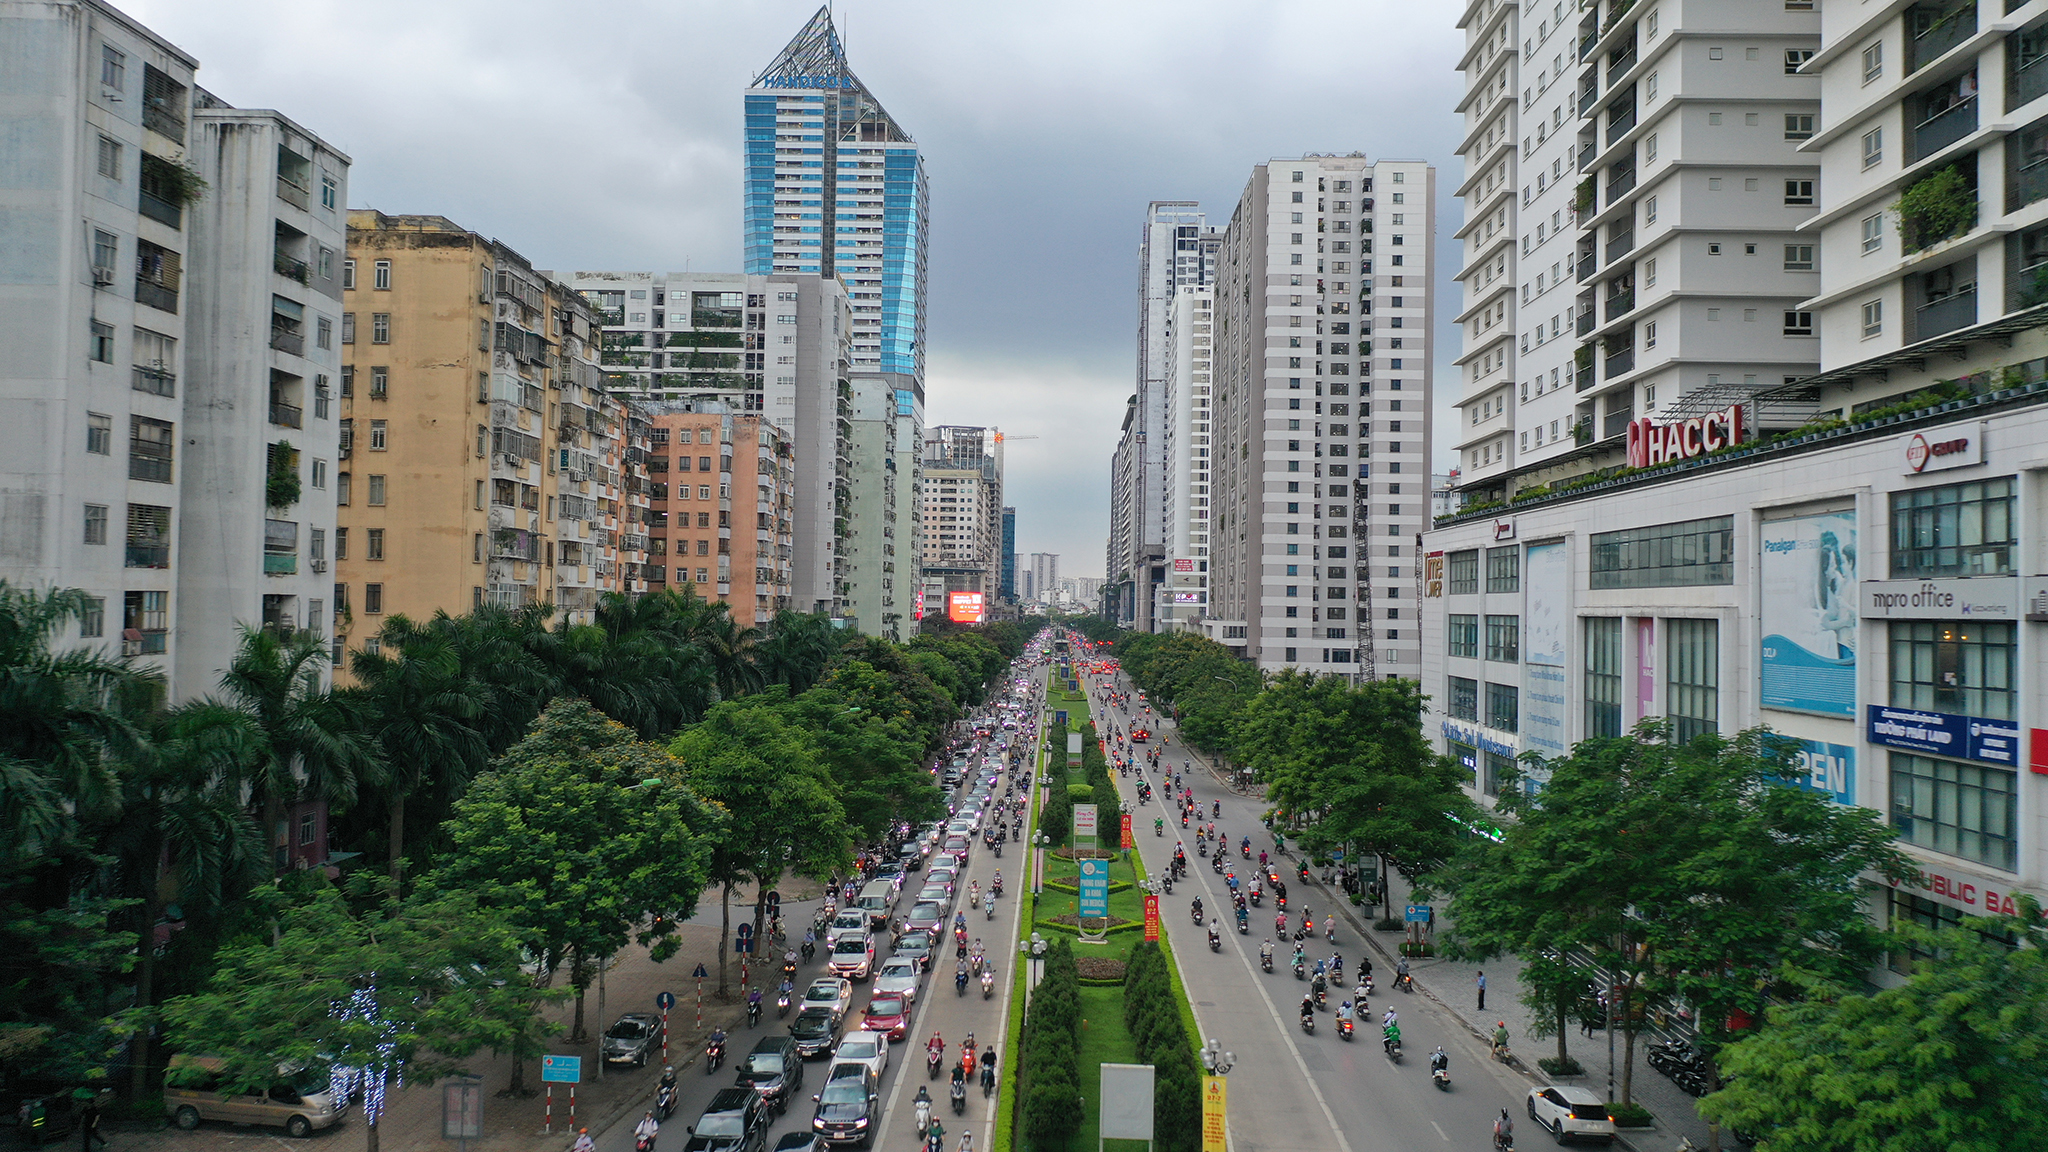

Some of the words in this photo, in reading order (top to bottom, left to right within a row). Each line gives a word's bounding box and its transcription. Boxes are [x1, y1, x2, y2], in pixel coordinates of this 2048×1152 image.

[763, 75, 839, 90] HANDICO
[1649, 404, 1743, 467] HACC1
[1911, 583, 1954, 608] office
[1927, 729, 1952, 745] LAND
